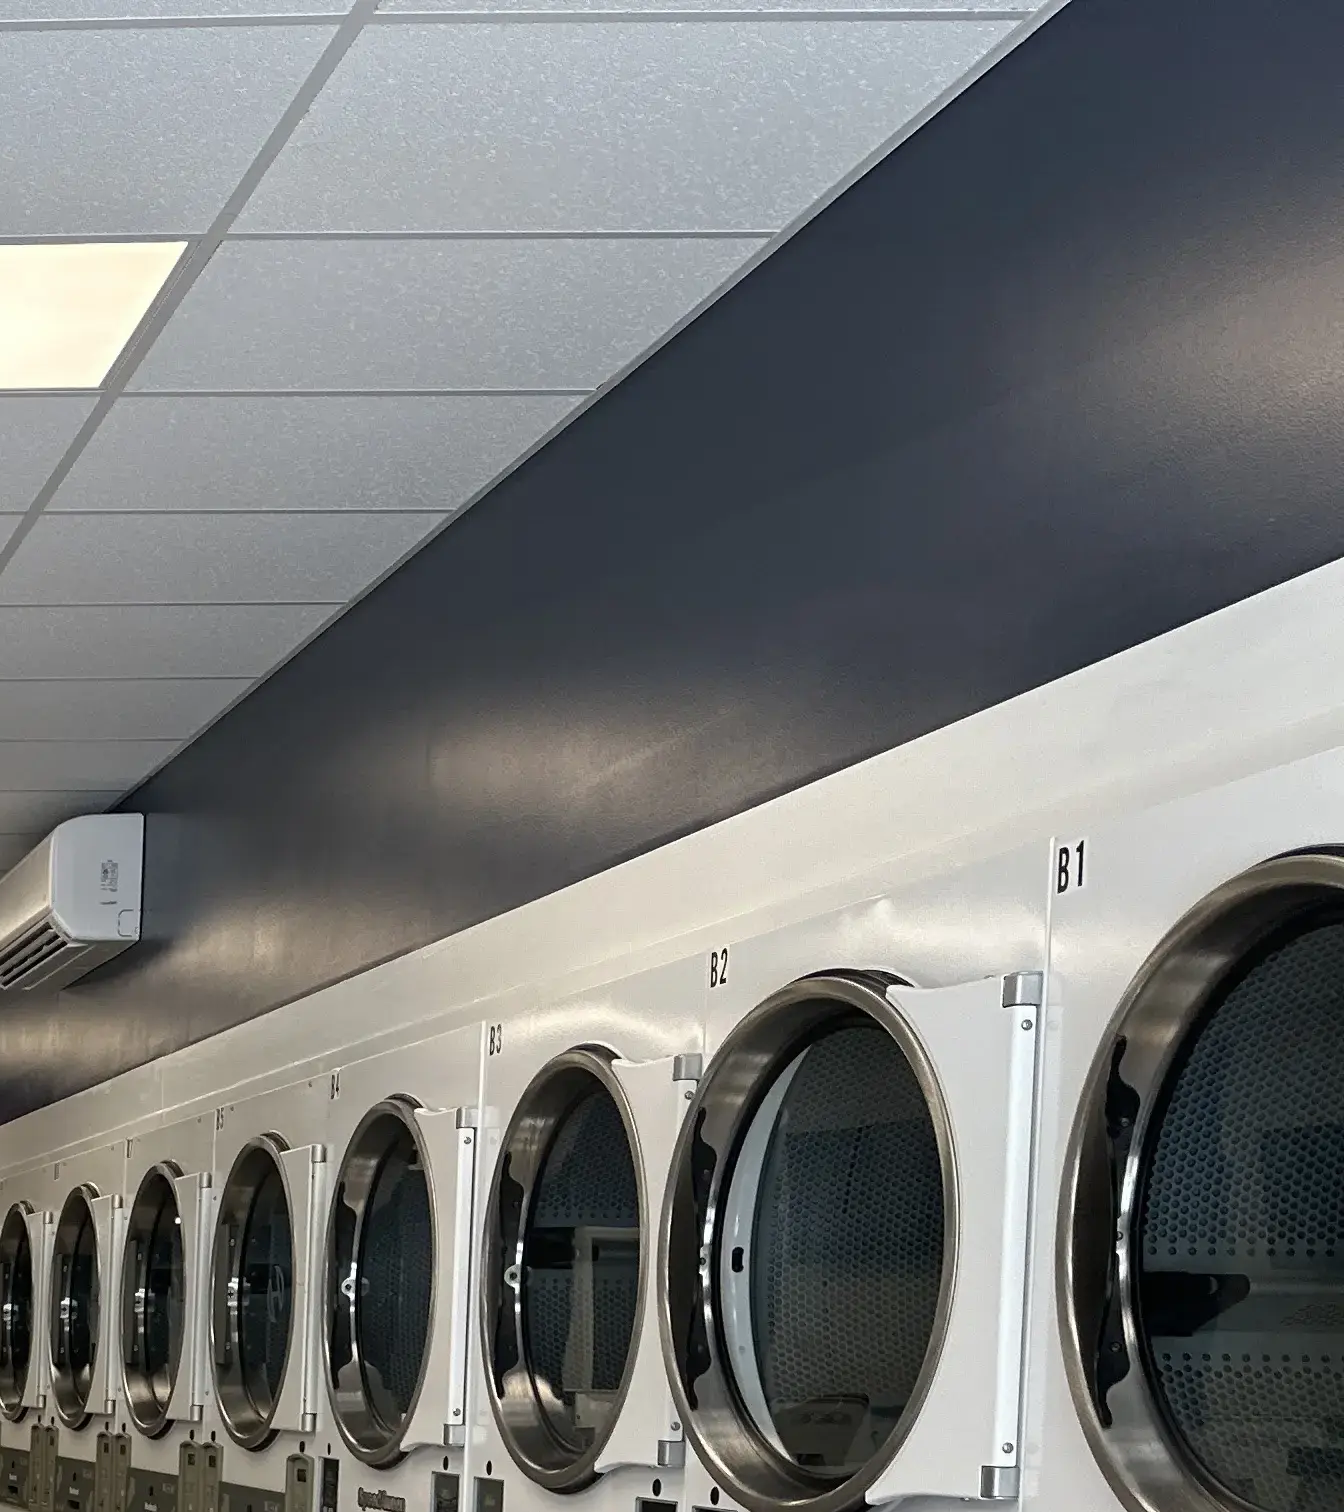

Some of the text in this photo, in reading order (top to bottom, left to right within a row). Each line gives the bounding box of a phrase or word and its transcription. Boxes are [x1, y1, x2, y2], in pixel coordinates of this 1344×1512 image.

[1057, 840, 1084, 894] B1
[710, 948, 728, 988] B2
[490, 1024, 502, 1056] B3
